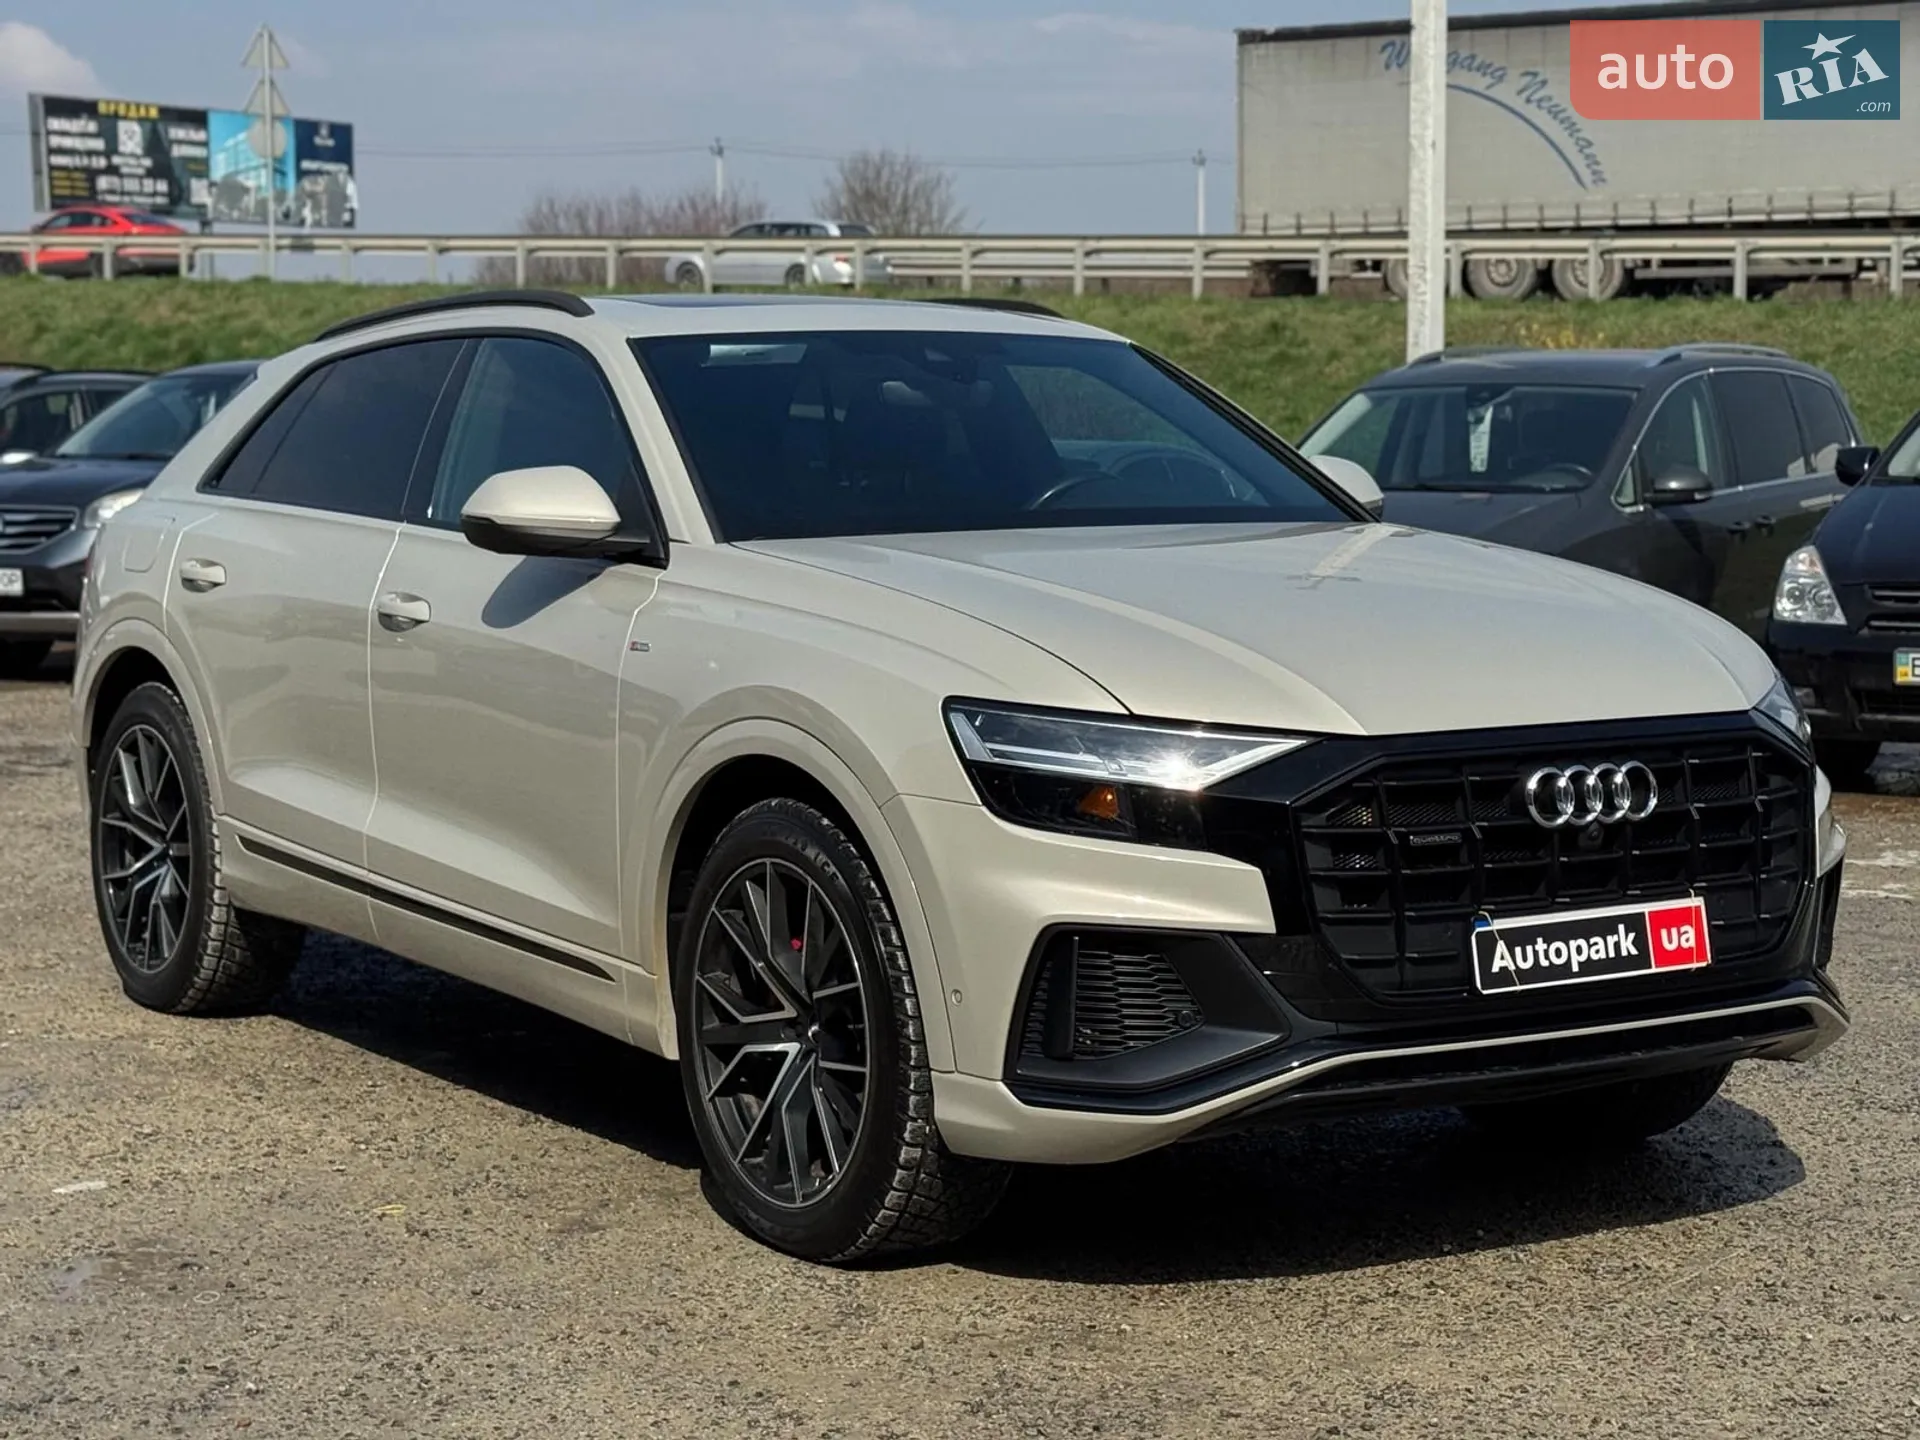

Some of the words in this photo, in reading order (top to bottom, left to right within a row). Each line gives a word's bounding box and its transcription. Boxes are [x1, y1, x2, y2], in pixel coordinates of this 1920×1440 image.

[1379, 39, 1509, 90] Wgang
[1491, 923, 1640, 973] Autopark
[1660, 924, 1695, 952] ua
